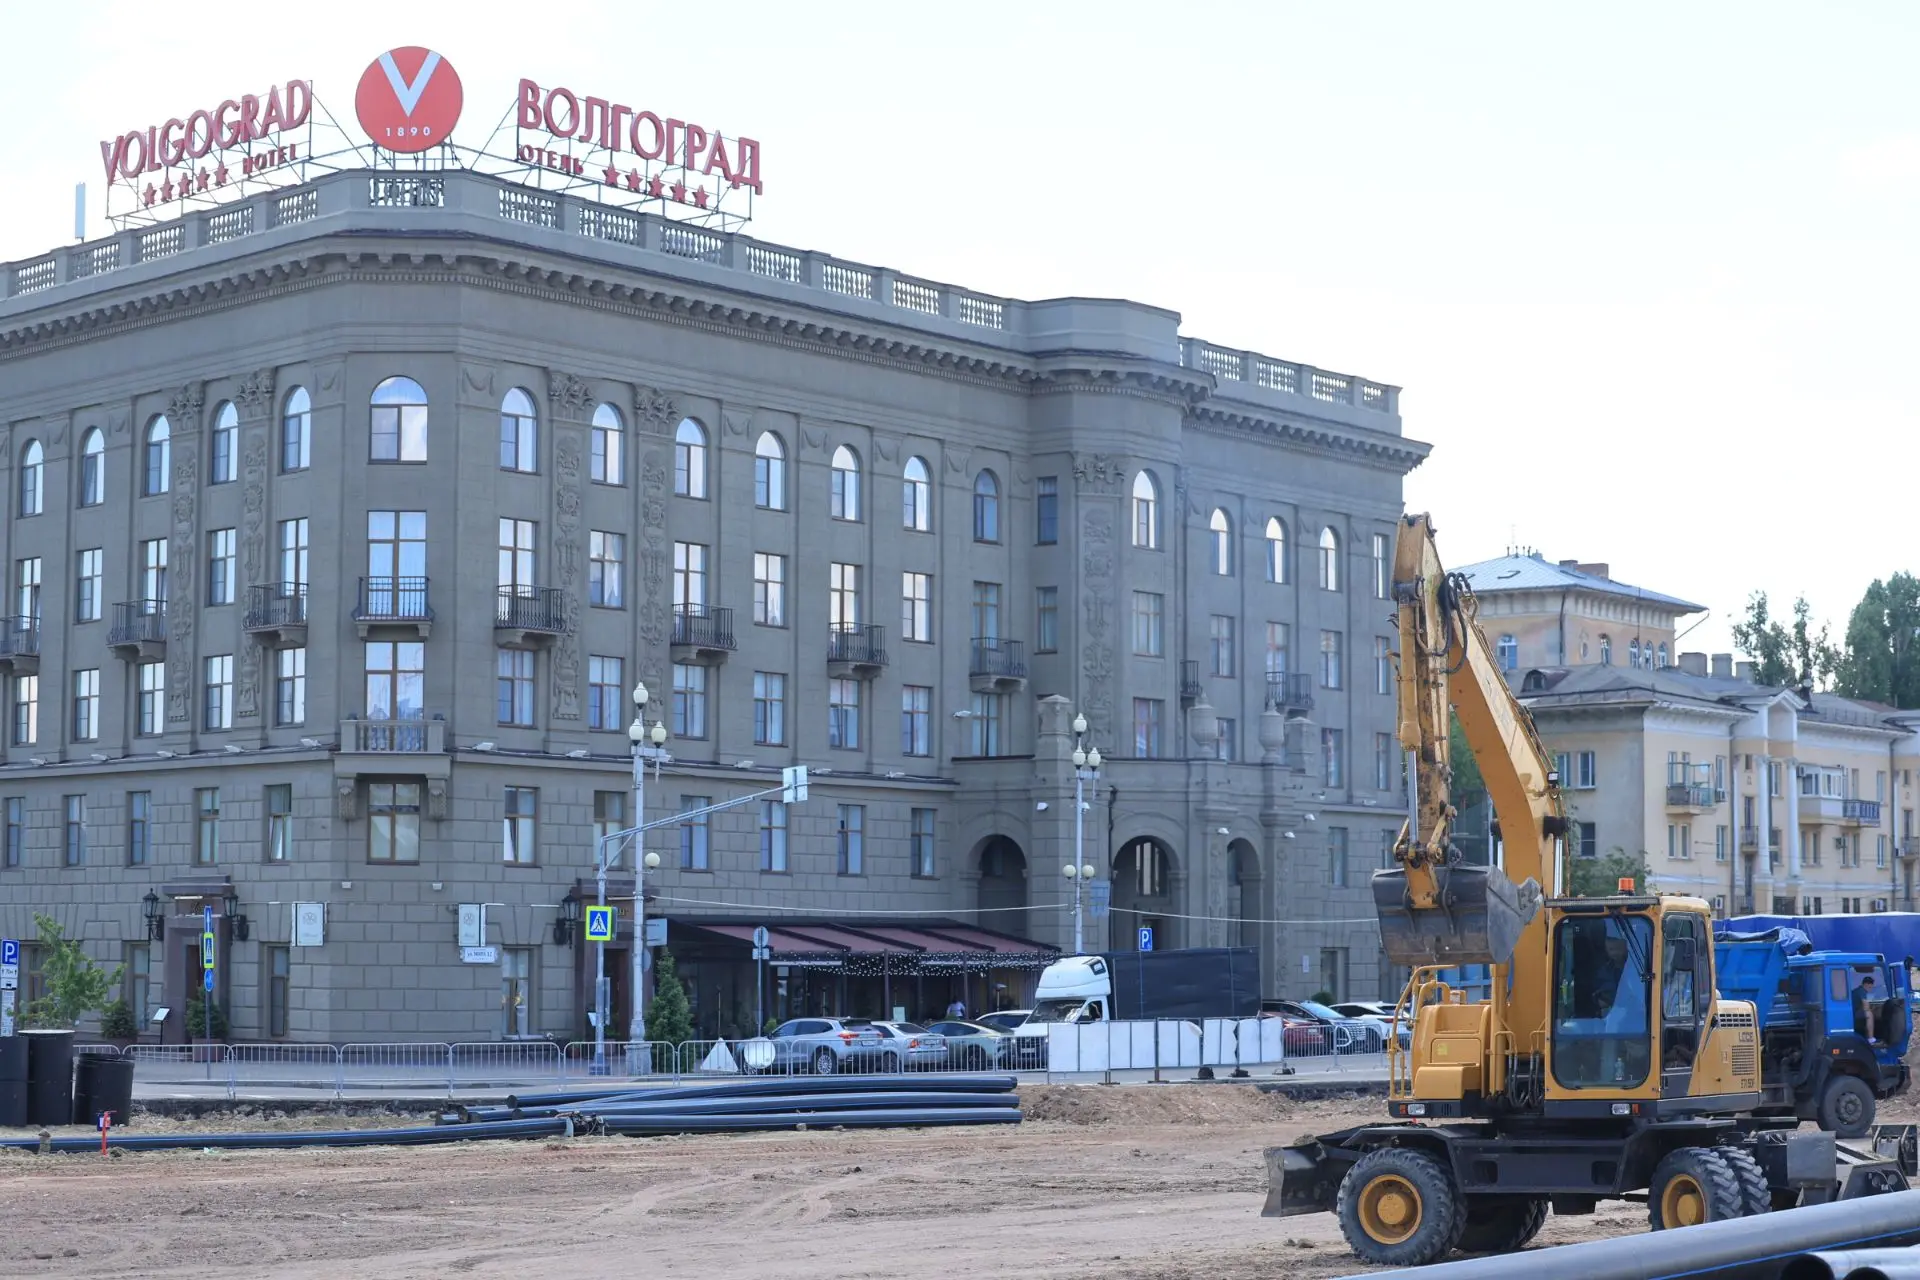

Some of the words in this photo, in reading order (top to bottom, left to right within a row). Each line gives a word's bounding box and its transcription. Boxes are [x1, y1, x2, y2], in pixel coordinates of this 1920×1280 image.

[100, 79, 312, 186] VOLGOGRAD
[386, 126, 431, 137] 1890
[518, 78, 763, 196] ВОЛГОГРАД
[242, 143, 298, 175] HOTEL
[519, 144, 584, 175] ОТЕЛЬ
[5, 942, 15, 963] P
[1141, 930, 1150, 949] P
